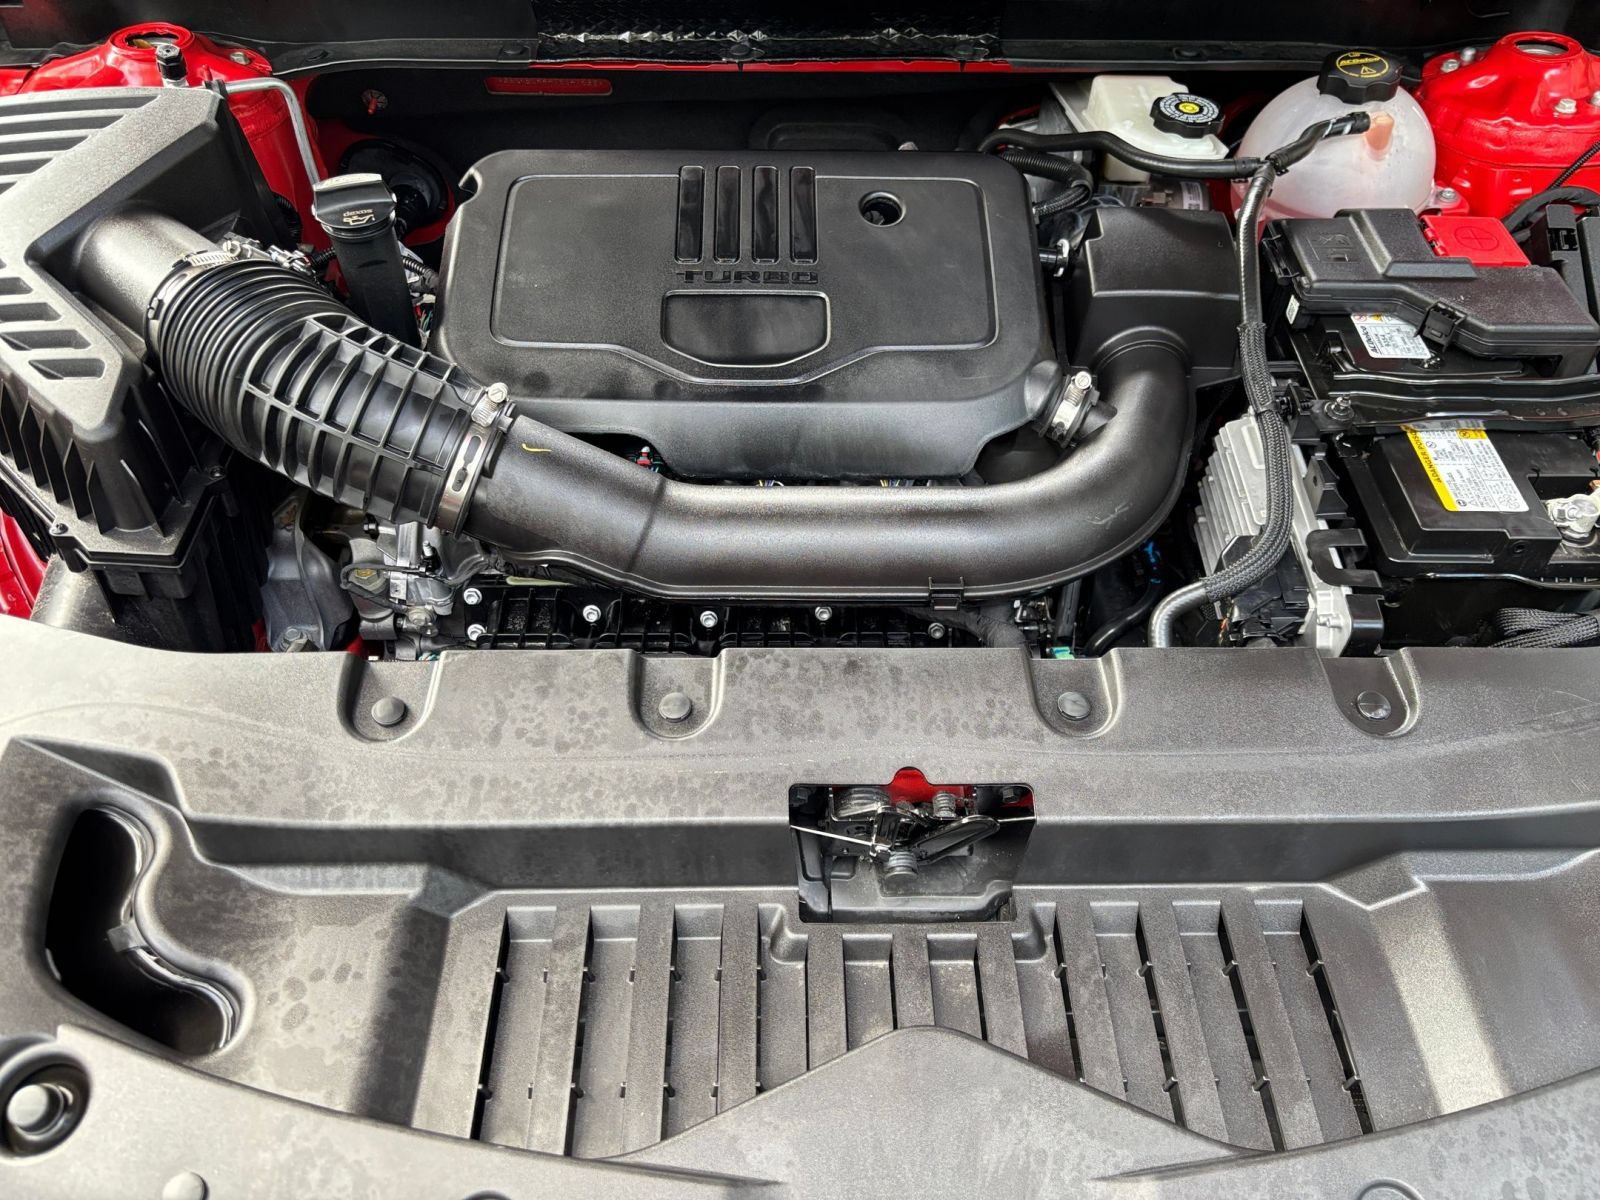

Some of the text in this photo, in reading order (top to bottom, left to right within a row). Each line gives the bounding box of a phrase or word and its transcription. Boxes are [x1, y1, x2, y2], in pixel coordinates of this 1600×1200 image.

[343, 208, 374, 217] dexos
[676, 270, 819, 284] TURBO
[1420, 451, 1439, 478] DANGER
